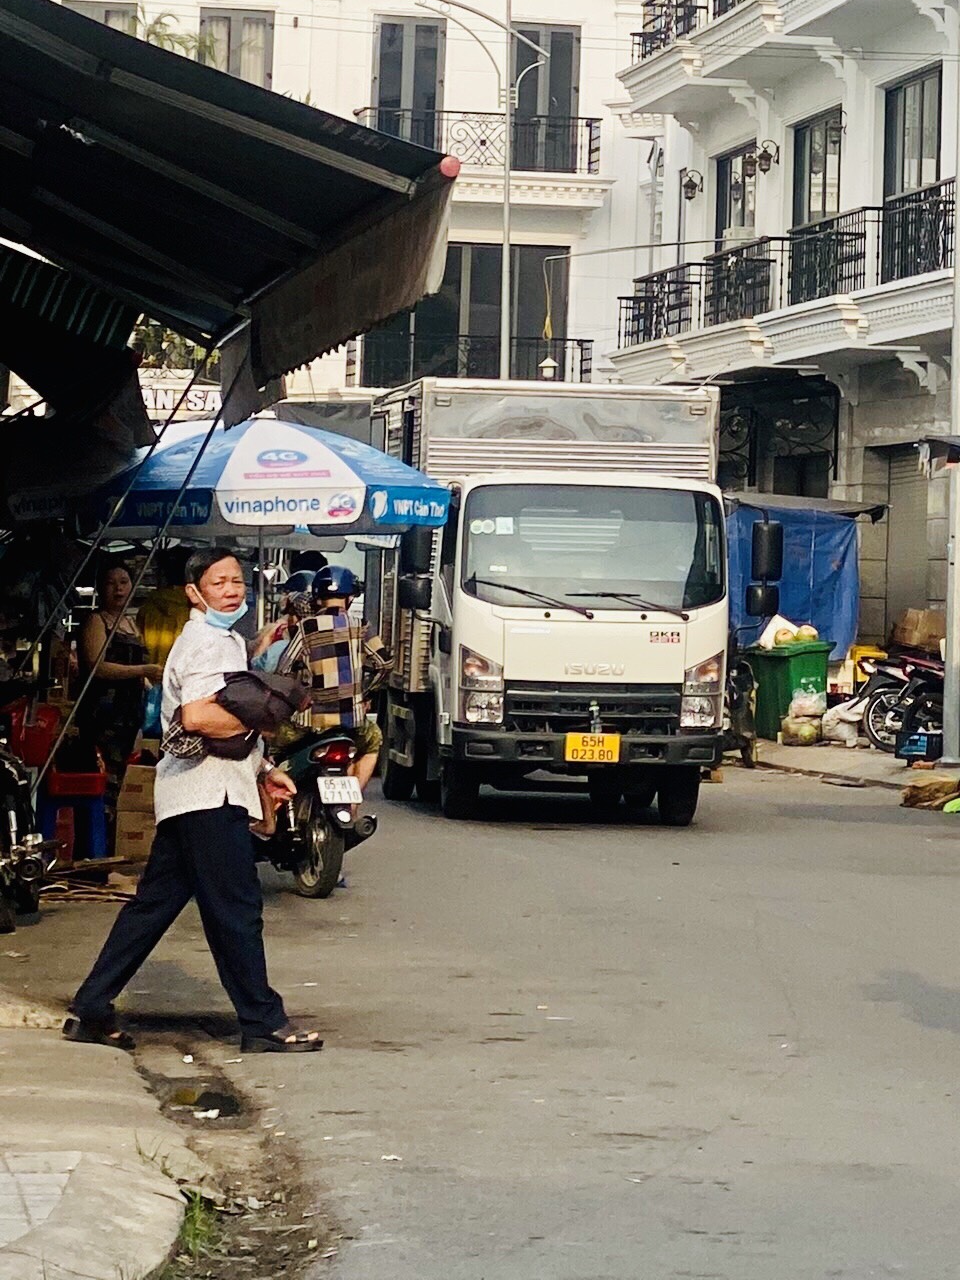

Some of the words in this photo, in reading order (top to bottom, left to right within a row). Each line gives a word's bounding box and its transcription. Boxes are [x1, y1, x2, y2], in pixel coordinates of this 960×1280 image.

[261, 452, 298, 462] 4G
[224, 495, 320, 516] vinaphone
[564, 663, 625, 676] ISUZU
[581, 736, 605, 748] 65H
[571, 748, 613, 761] 023.80
